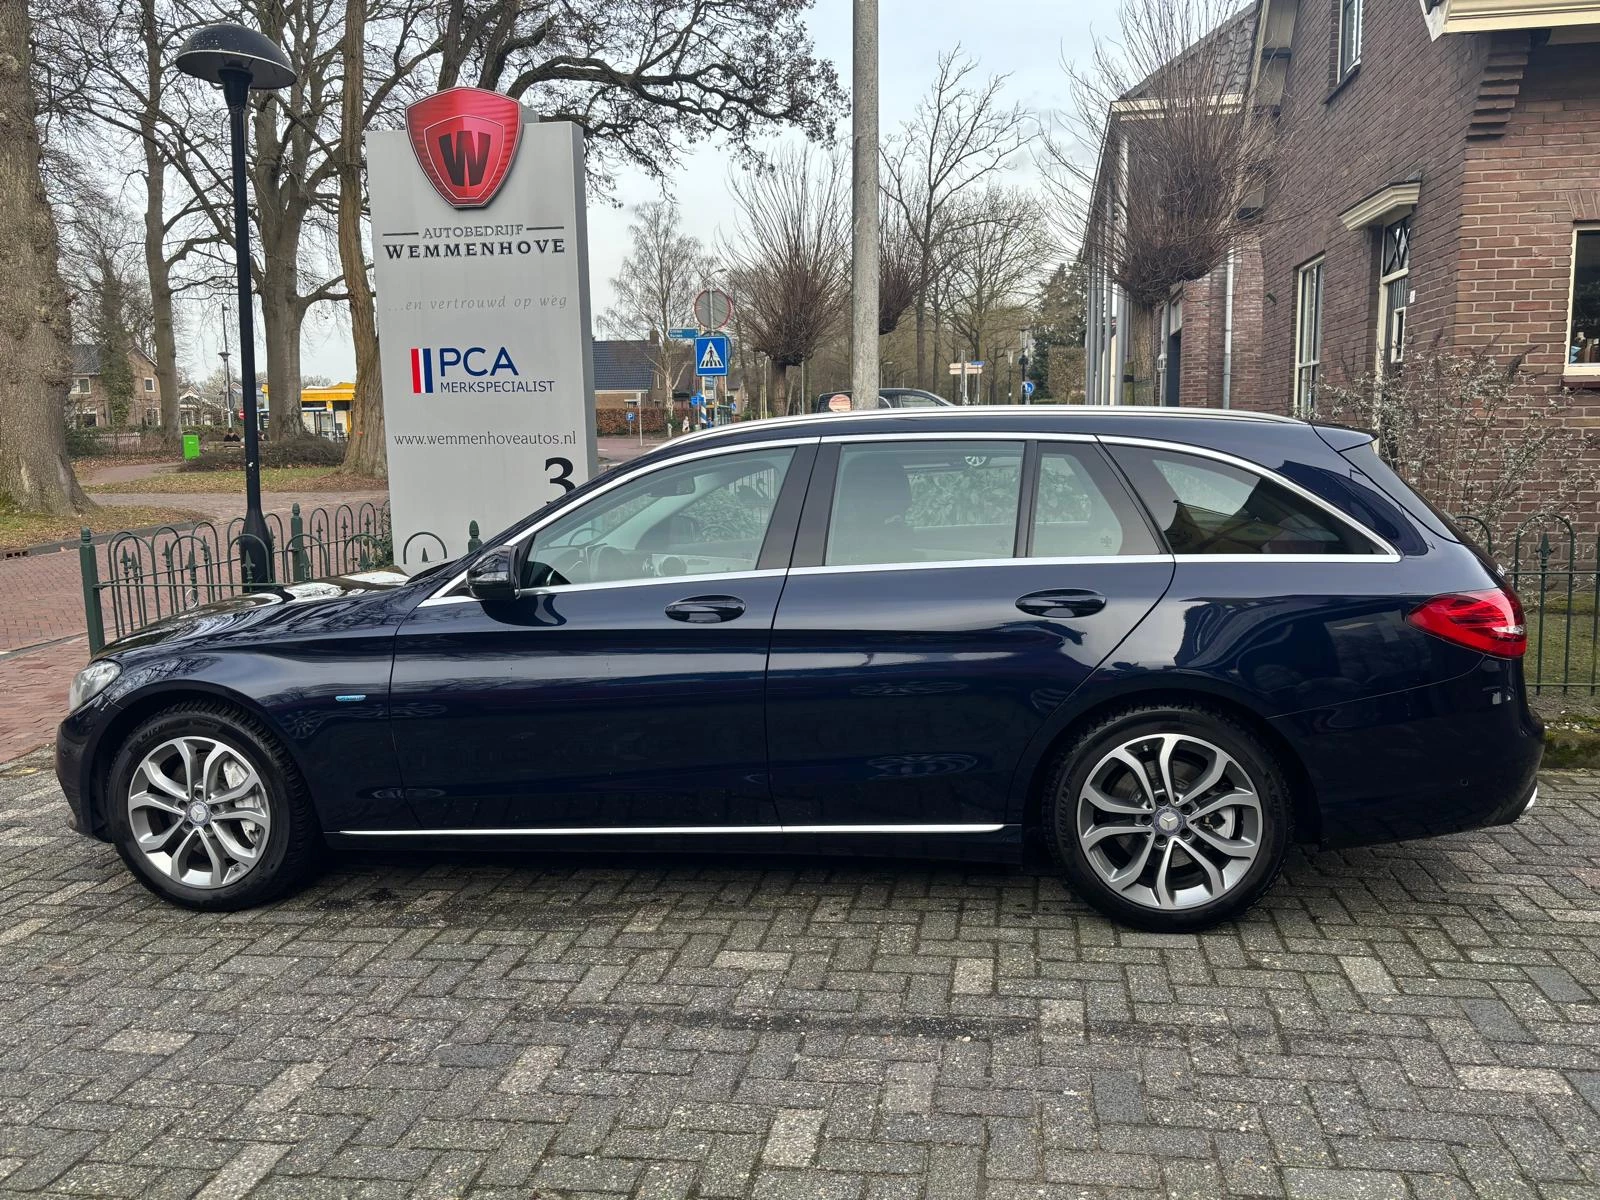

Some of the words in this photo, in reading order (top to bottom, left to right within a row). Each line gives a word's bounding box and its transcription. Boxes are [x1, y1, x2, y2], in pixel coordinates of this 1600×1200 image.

[438, 130, 491, 187] W
[422, 224, 524, 239] AUTOBEDRIJF
[384, 238, 565, 259] WEMMENHOVE
[430, 295, 506, 310] vertrouwd
[513, 297, 532, 308] op
[539, 295, 567, 309] weg
[439, 346, 519, 377] PCA
[440, 380, 555, 393] MERKSPECIALIST
[394, 431, 577, 445] www.wemmenhoveautos.nl
[544, 456, 577, 504] 3
